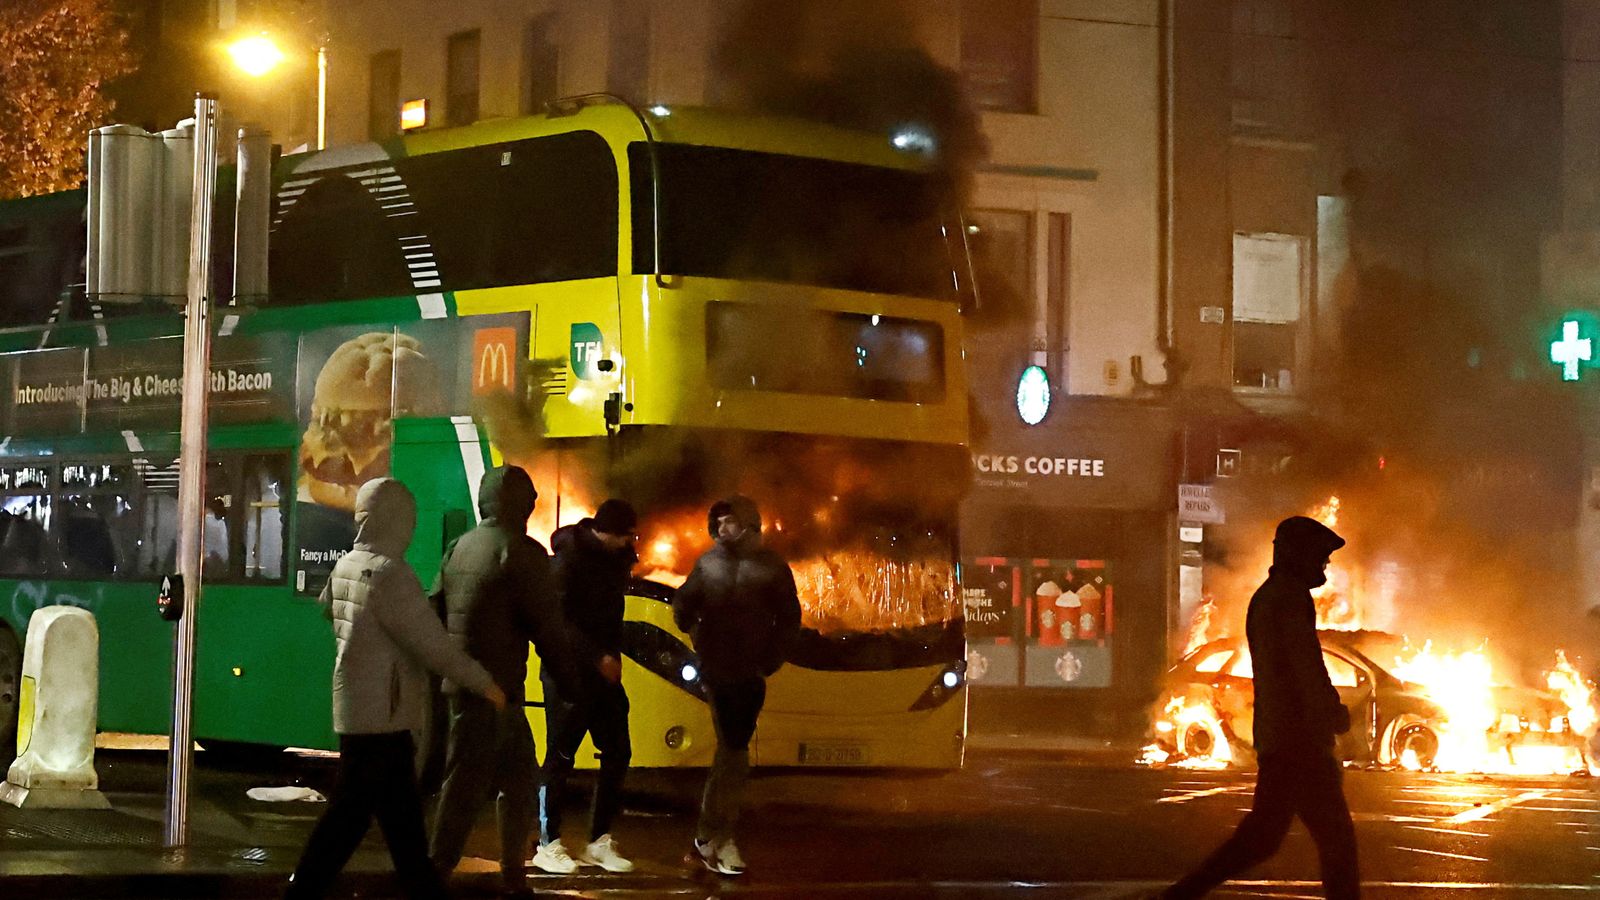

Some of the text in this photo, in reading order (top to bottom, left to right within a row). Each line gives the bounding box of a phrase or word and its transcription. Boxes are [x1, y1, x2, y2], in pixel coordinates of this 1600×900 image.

[15, 369, 272, 406] Introducing The Big & Chees ith Bacon
[971, 455, 1104, 477] CKS COFFEE
[301, 548, 348, 564] Fancy a McD
